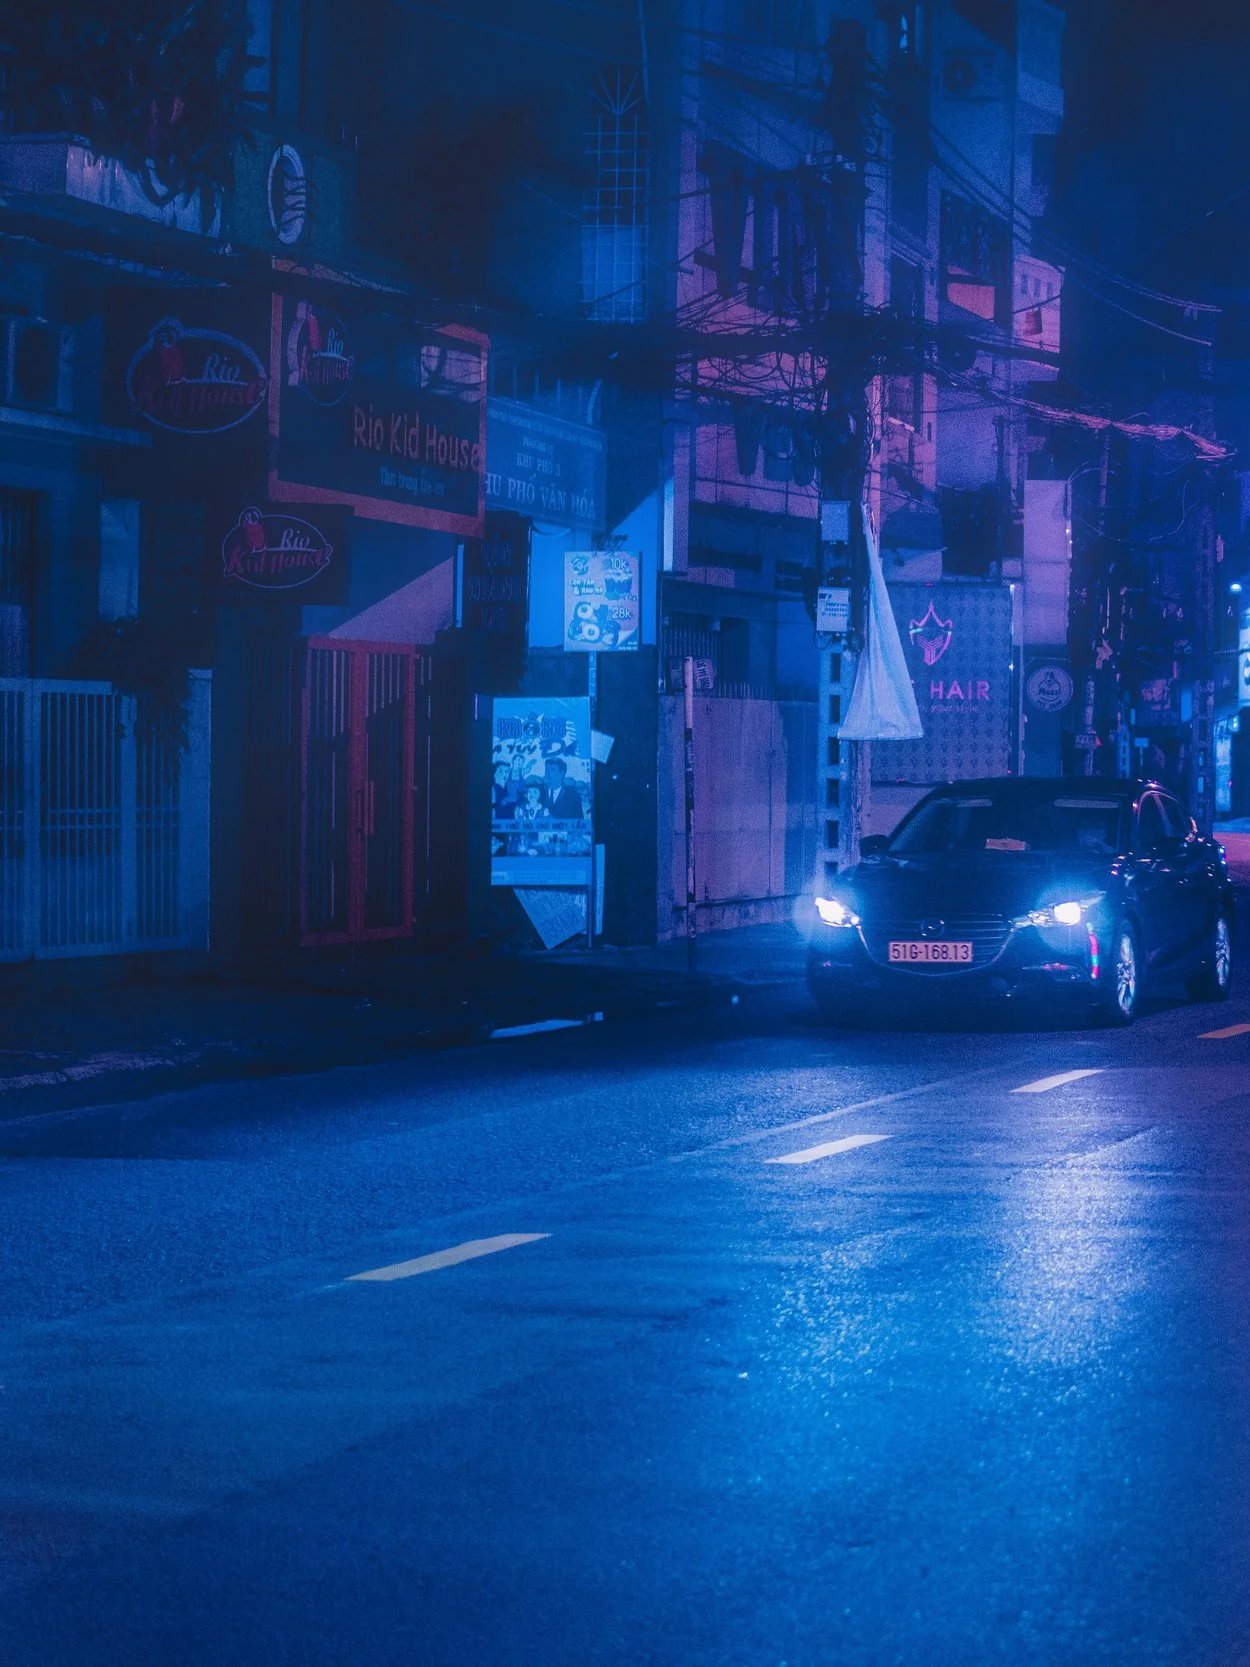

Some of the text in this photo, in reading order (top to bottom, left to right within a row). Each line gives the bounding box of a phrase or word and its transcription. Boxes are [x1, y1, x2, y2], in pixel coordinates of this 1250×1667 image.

[203, 353, 240, 382] Rio
[353, 404, 384, 451] Rio
[390, 412, 419, 459] Kid
[426, 422, 480, 472] House
[516, 453, 534, 470] KHU
[556, 464, 561, 477] 3
[508, 472, 536, 504] PHỐ
[541, 484, 566, 513] VĂN
[571, 489, 597, 520] HÓA
[280, 527, 311, 550] Rio
[227, 544, 329, 575] Kid House
[930, 680, 989, 701] HAIR
[892, 944, 969, 961] 51G-168.13
